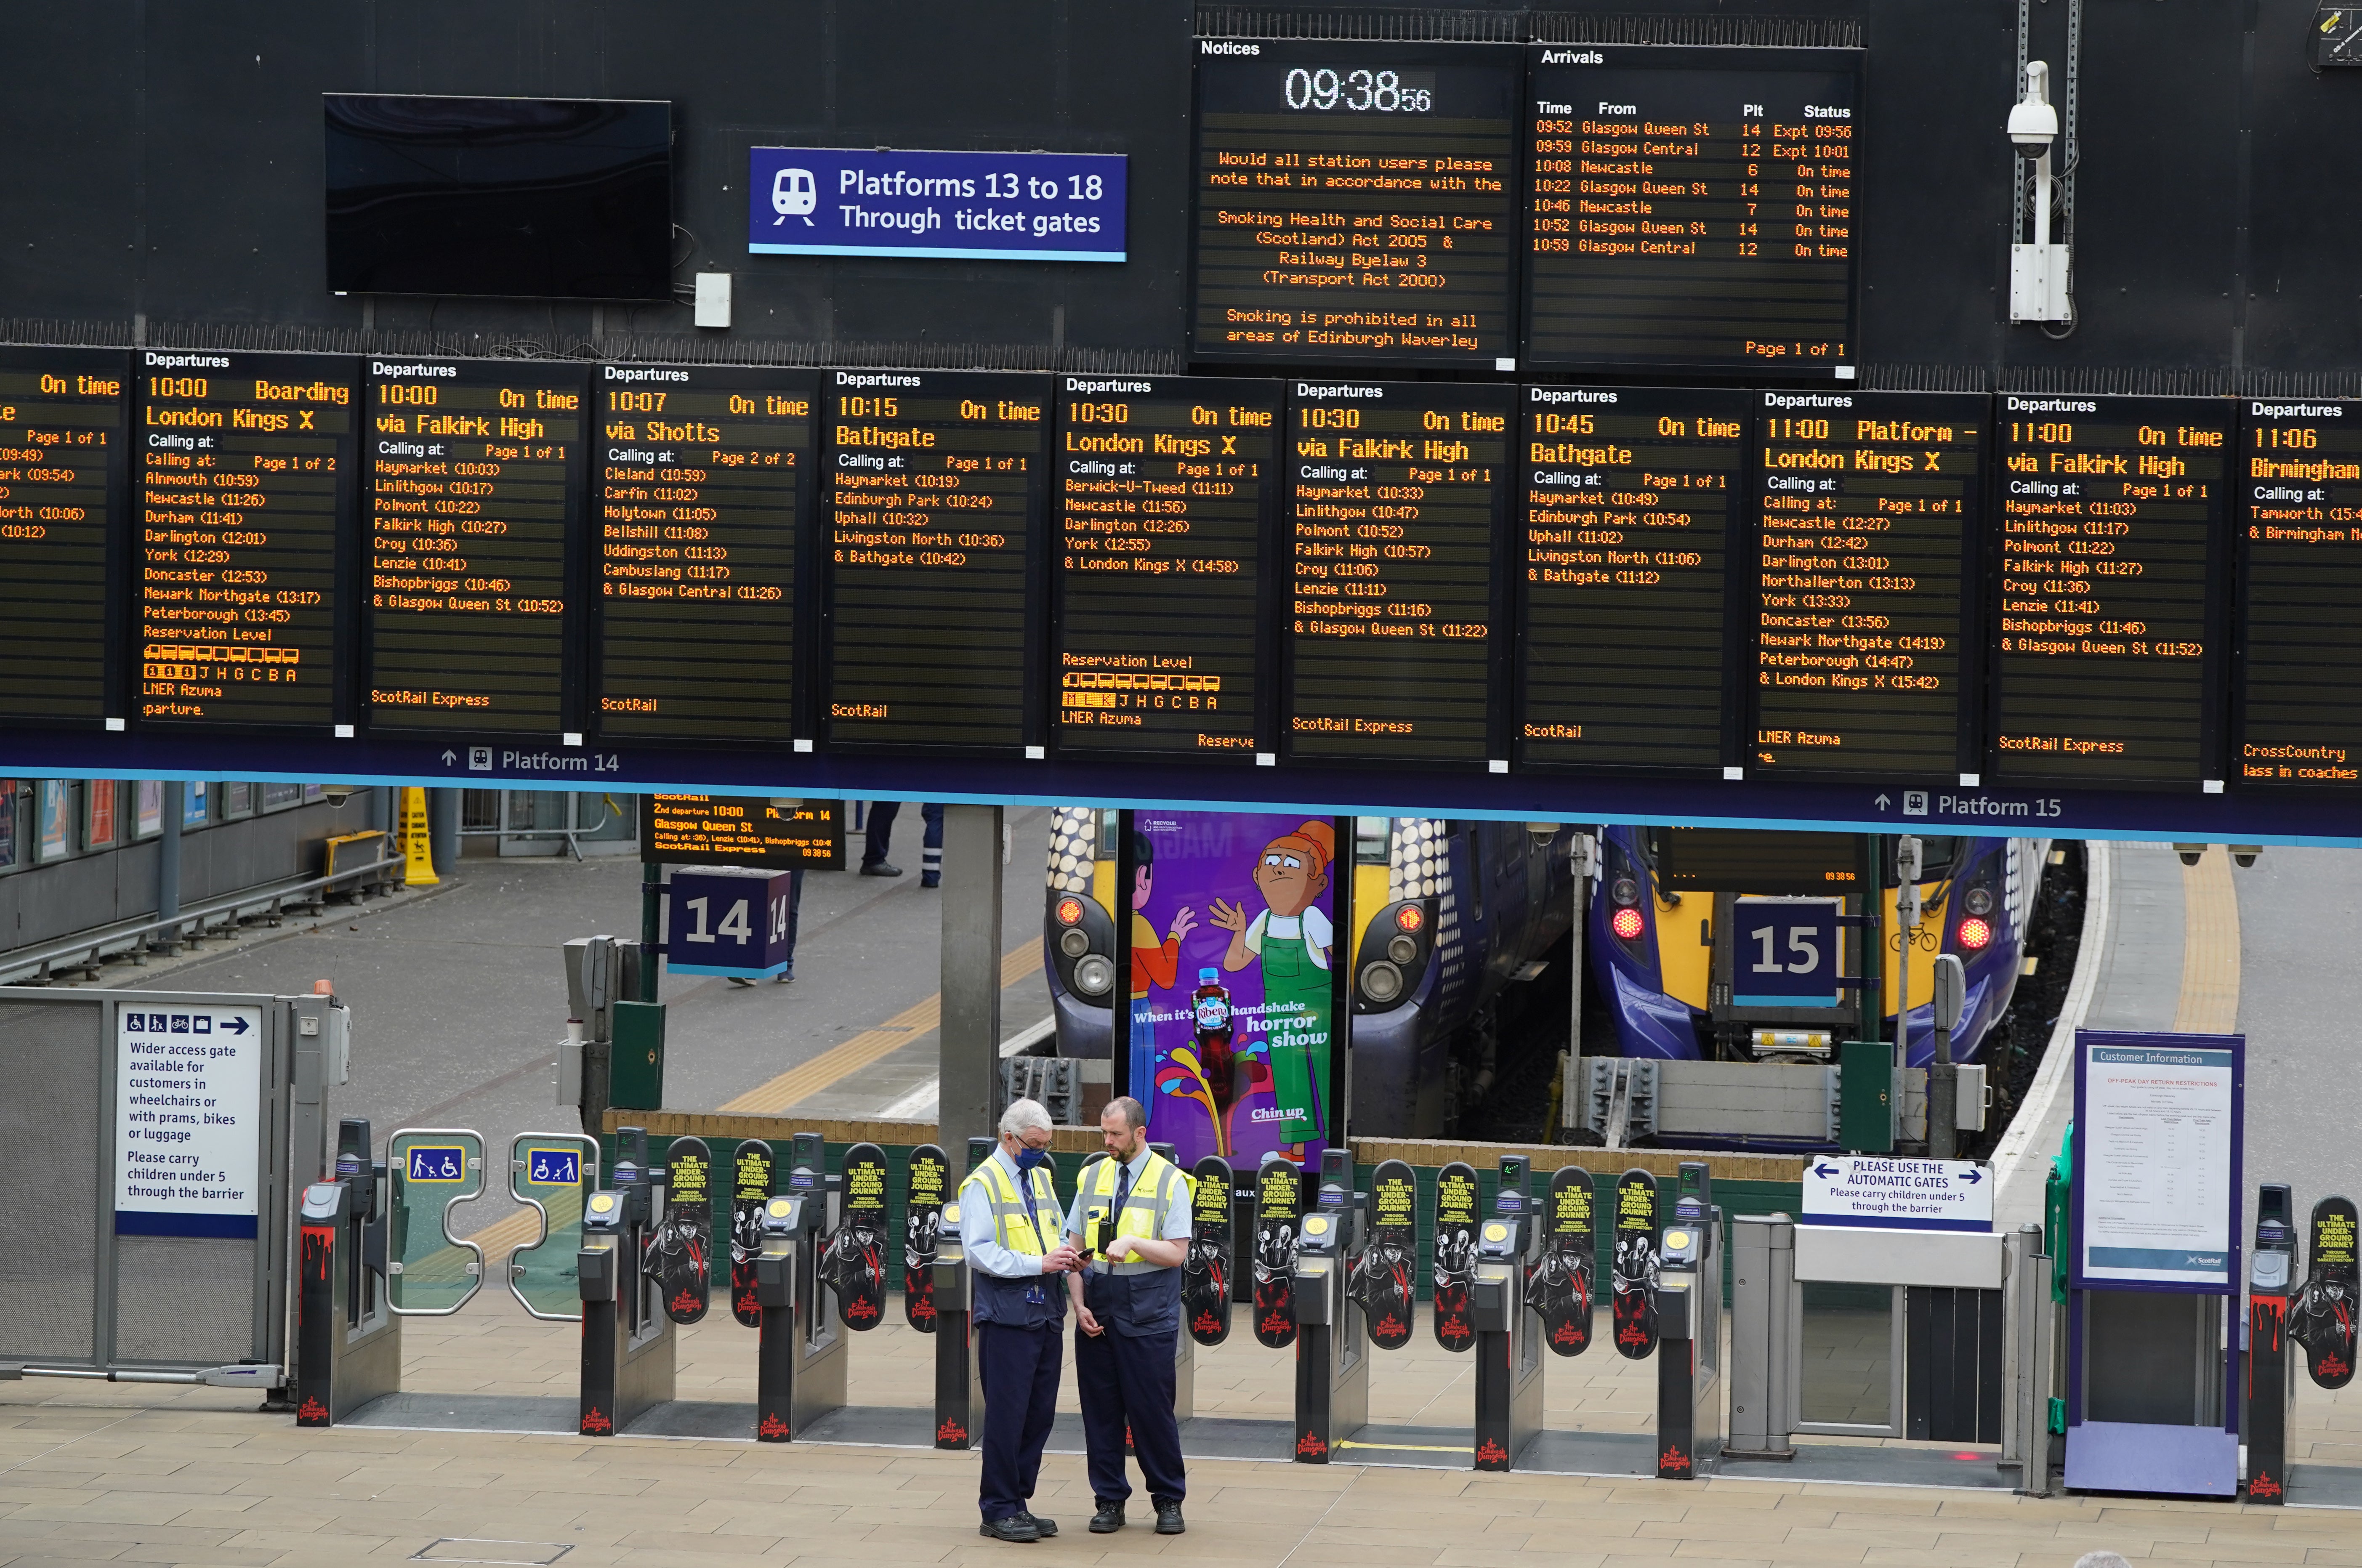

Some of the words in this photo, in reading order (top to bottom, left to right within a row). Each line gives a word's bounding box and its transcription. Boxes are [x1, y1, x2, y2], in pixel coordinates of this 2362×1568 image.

[1202, 41, 1259, 55] Notices
[1542, 50, 1603, 64] Arrivals
[1537, 101, 1572, 114] Time
[1599, 102, 1636, 114] From
[1744, 104, 1763, 117] Plt
[1804, 105, 1850, 117] Status
[1582, 141, 1637, 157] Glasgow
[1644, 142, 1697, 155] Central
[1742, 144, 1760, 157] 12
[1774, 144, 1807, 160] Expt
[1815, 145, 1849, 158] 10:01
[1220, 152, 1266, 166] Would
[1275, 154, 1299, 166] all
[1309, 154, 1370, 167] station
[1379, 159, 1427, 169] users
[1436, 157, 1492, 172] please
[1536, 159, 1571, 173] 10:08
[1581, 160, 1652, 174] Newcastle
[1748, 164, 1758, 176] 6
[1798, 165, 1814, 177] On
[1821, 165, 1850, 178] time
[841, 170, 975, 197] Platforms
[986, 173, 1019, 198] 13
[1028, 177, 1058, 199] to
[1069, 175, 1102, 200] 18
[840, 205, 940, 234] Through
[955, 208, 1025, 231] ticket
[1033, 213, 1100, 237] gates
[1227, 309, 1291, 325] Smoking
[1301, 314, 1317, 323] is
[1325, 312, 1416, 327] prohibited
[1427, 314, 1442, 326] in
[1451, 315, 1476, 327] all
[1227, 332, 1274, 342] areas
[1283, 330, 1300, 343] of
[1309, 330, 1393, 347] Edinburgh
[1402, 333, 1477, 350] Waverley
[146, 353, 229, 369] Departures
[41, 375, 66, 393] On
[77, 376, 120, 395] time
[151, 377, 207, 397] 10:00
[256, 380, 348, 404] Boarding
[610, 392, 666, 411] 10:07
[841, 397, 897, 416] 10:15
[2008, 397, 2096, 413] Departures
[147, 406, 222, 426] London
[234, 409, 288, 431] Kings
[300, 411, 313, 429] X
[1536, 414, 1593, 433] 10:45
[1659, 417, 1684, 436] On
[1697, 418, 1740, 437] time
[377, 414, 406, 433] via
[418, 415, 489, 435] Falkirk
[501, 417, 543, 440] High
[606, 422, 635, 440] via
[647, 422, 719, 442] Shotts
[1770, 419, 1828, 439] 11:00
[1858, 420, 1952, 441] Platform
[837, 426, 934, 449] Bathgate
[2256, 428, 2316, 448] 11:06
[376, 460, 447, 476] Haymarket
[455, 463, 500, 476] (10:03)
[606, 468, 654, 480] Cleland
[2251, 458, 2359, 481] Birmingham
[146, 472, 207, 485] Alnmouth
[1066, 479, 1185, 494] Berwick-U-Tweed
[1192, 482, 1233, 495] (11:11)
[2011, 481, 2058, 497] Calling
[2063, 483, 2079, 494] at:
[836, 492, 901, 508] Edinburgh
[908, 494, 939, 506] Park
[947, 495, 992, 508] (10:24)
[1297, 504, 1365, 520] Linlithgow
[1372, 506, 1418, 518] (10:47)
[1529, 529, 1571, 545] Uphall
[1578, 531, 1623, 543] (11:02)
[2005, 539, 2061, 553] Polmont
[2069, 541, 2115, 554] (11:22)
[1762, 574, 1862, 588] Northallerton
[1869, 577, 1915, 590] (13:13)
[144, 683, 174, 695] LNER
[181, 684, 221, 696] Azuma
[1293, 718, 1348, 731] ScotRail
[1355, 719, 1412, 734] Express
[503, 751, 587, 770] Platform
[595, 754, 619, 771] 14
[2244, 744, 2345, 762] CrossCountry
[1939, 796, 2027, 815] Platform
[2036, 799, 2061, 816] 15
[655, 819, 697, 831] Glasgow
[702, 821, 735, 831] Queen
[741, 822, 753, 832] St
[687, 897, 751, 944] 14
[770, 895, 786, 943] 14
[1752, 926, 1819, 973] 15
[1134, 1012, 1173, 1023] When
[1231, 1001, 1305, 1015] handshake
[1198, 1007, 1226, 1019] Ribena
[1247, 1016, 1317, 1033] horror
[1272, 1031, 1327, 1047] show
[131, 1043, 165, 1053] Wider
[169, 1047, 206, 1055] access
[210, 1046, 235, 1058] gate
[2101, 1052, 2144, 1061] Customer
[2146, 1053, 2202, 1063] Information
[130, 1060, 183, 1071] available
[187, 1061, 204, 1072] for
[130, 1078, 190, 1089] customers
[194, 1079, 205, 1089] in
[130, 1094, 200, 1106] wheelchairs
[1251, 1107, 1284, 1120] Chin
[1286, 1108, 1304, 1121] up
[128, 1151, 165, 1163] Please
[169, 1156, 199, 1167] carry
[128, 1168, 176, 1180] children
[181, 1170, 215, 1181] under
[219, 1172, 225, 1182] 5
[1854, 1161, 1894, 1172] PLEASE
[1899, 1163, 1919, 1173] USE
[1923, 1164, 1943, 1174] THE
[1848, 1175, 1911, 1186] AUTOMATIC
[1915, 1177, 1948, 1188] GATES
[1852, 1202, 1889, 1212] through
[1910, 1204, 1942, 1213] barrier
[672, 1301, 701, 1313] Dungeon
